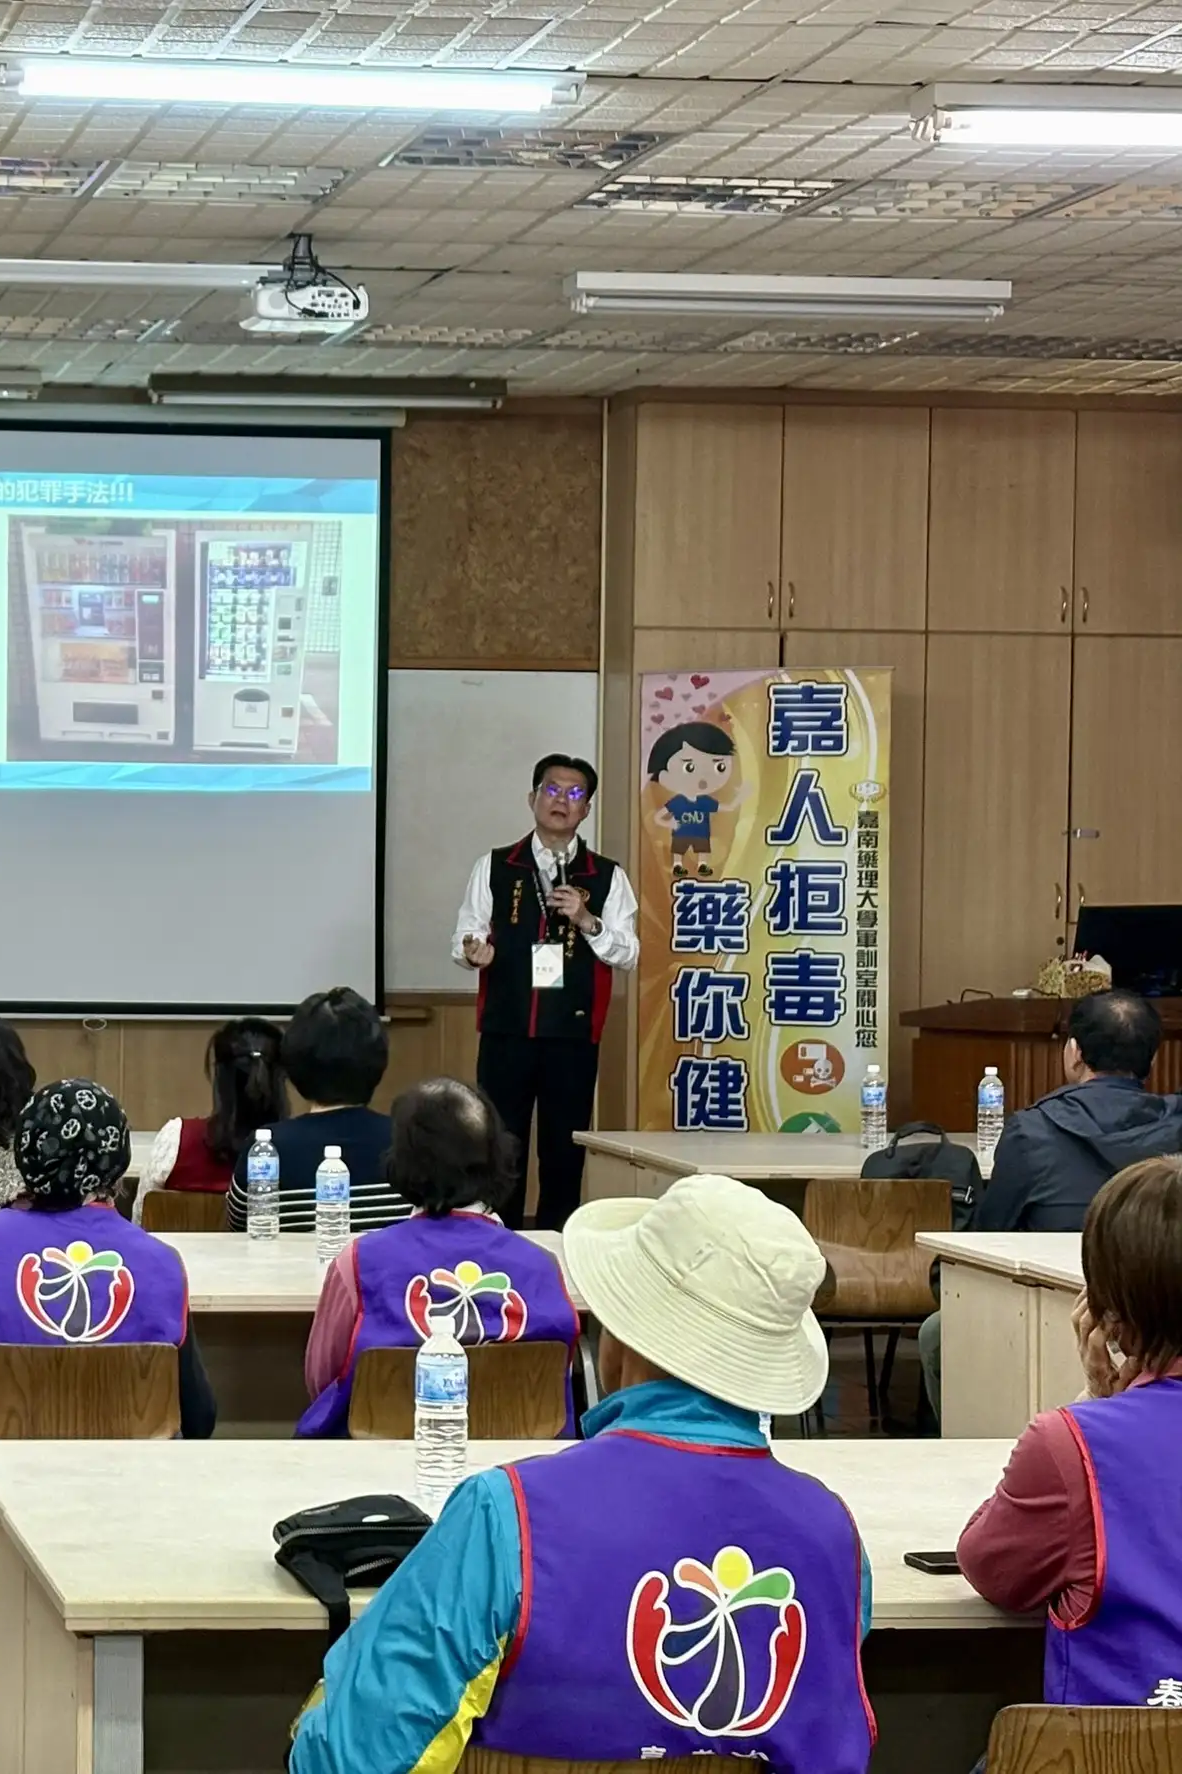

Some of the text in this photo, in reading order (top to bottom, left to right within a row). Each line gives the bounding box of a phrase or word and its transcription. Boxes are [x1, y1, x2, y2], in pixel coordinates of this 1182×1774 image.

[681, 810, 704, 825] CNU
[764, 681, 848, 1028] 嘉人拒毒
[855, 810, 879, 1049] 嘉南藥理大學軍訓室關心您
[669, 878, 750, 1133] 藥你健
